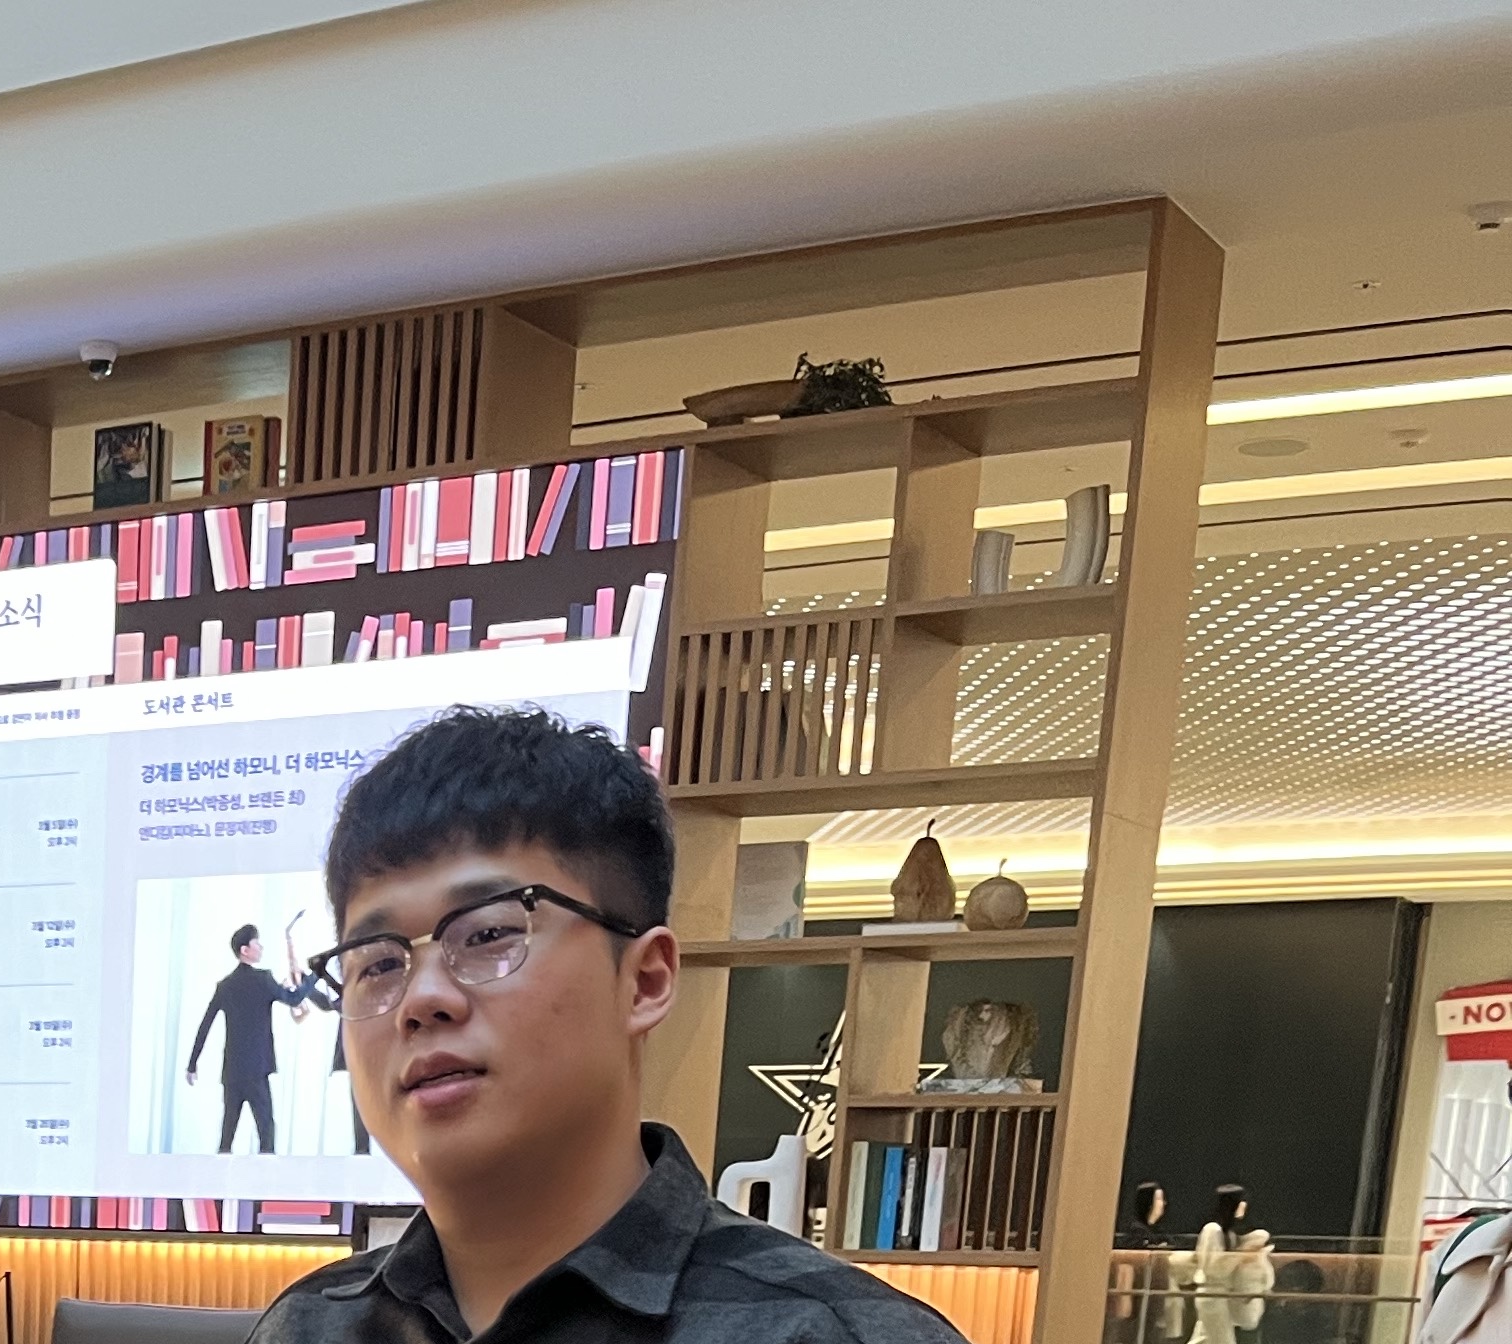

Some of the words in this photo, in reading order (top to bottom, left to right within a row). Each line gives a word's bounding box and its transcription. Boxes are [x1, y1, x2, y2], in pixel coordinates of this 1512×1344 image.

[143, 695, 186, 715] 도서관
[191, 691, 235, 713] 콘서트
[140, 762, 183, 784] 경계를
[187, 758, 230, 781] 넘어선
[285, 753, 301, 773] 더
[1462, 1001, 1512, 1026] NO
